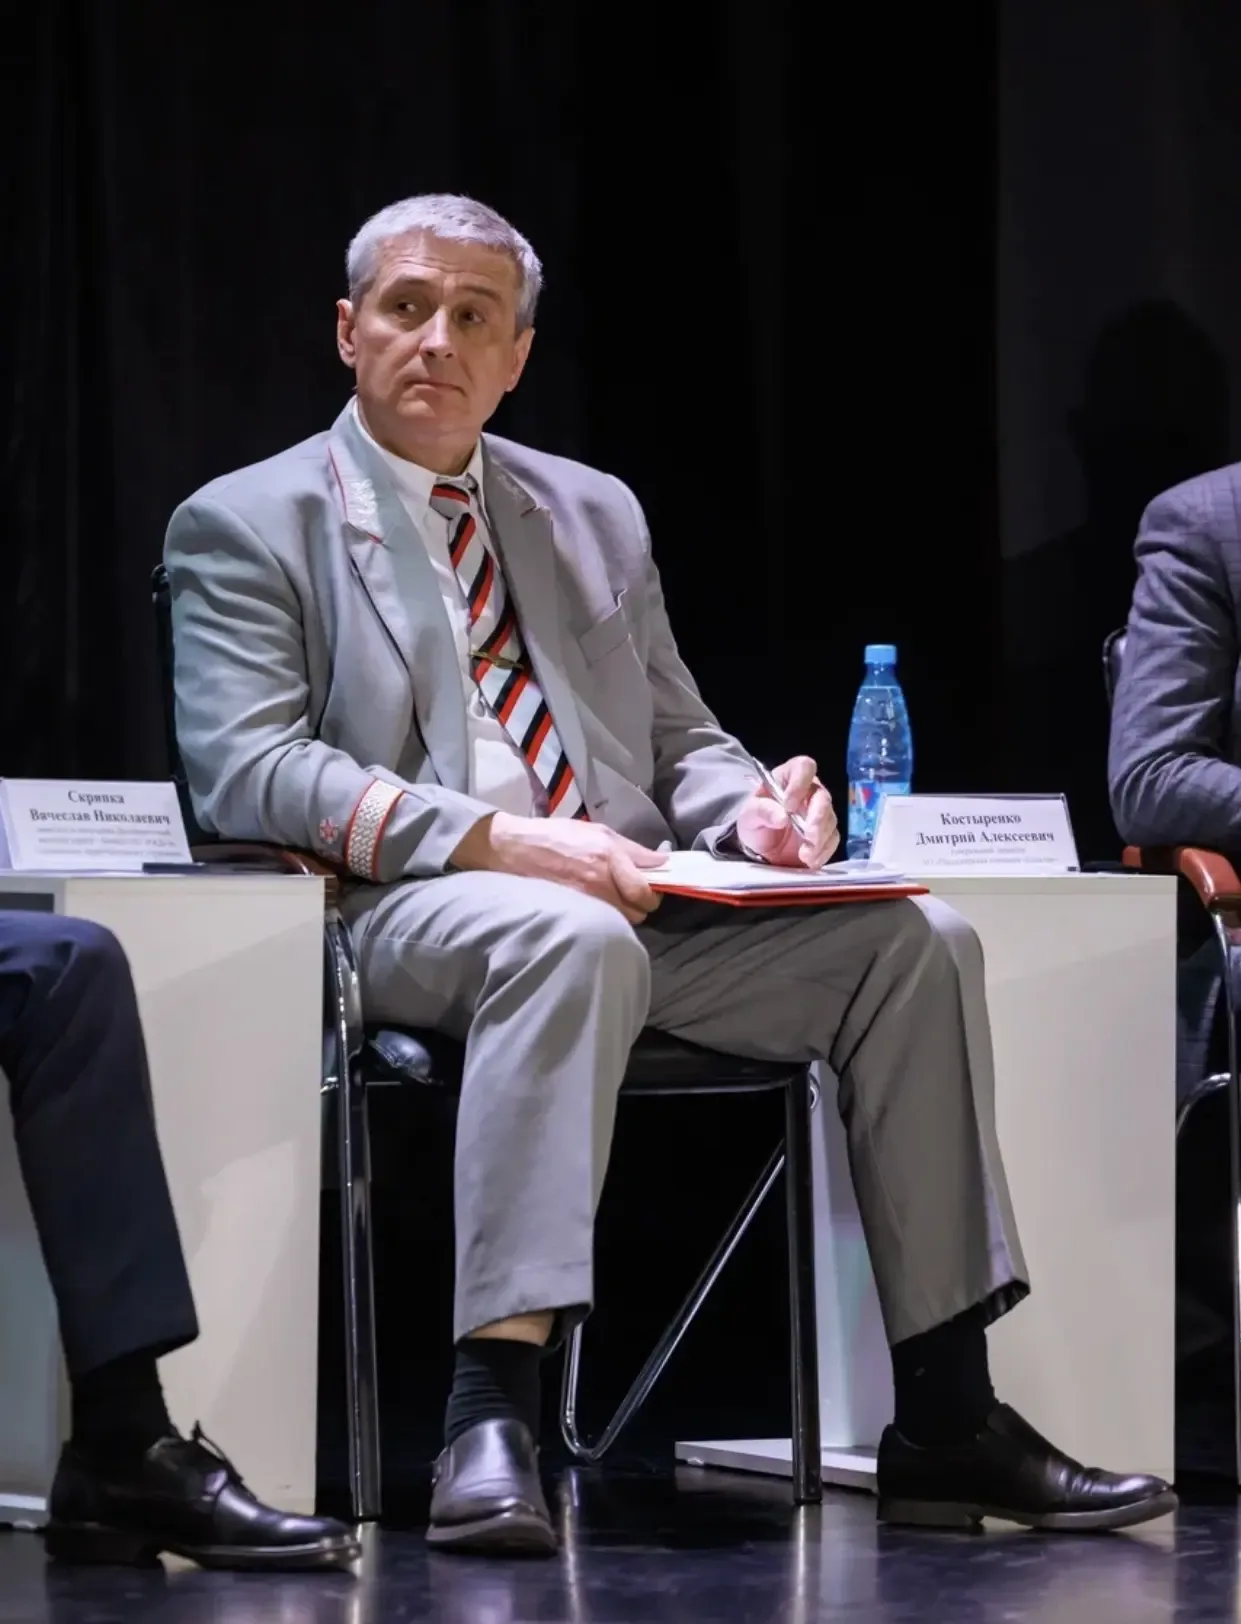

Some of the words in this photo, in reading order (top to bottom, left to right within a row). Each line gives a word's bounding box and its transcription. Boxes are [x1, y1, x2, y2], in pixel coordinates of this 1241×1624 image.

[30, 809, 91, 822] Вячеслав
[94, 810, 170, 825] Николаевич
[940, 813, 1022, 828] Костыренко
[916, 831, 976, 846] Дмитрий
[980, 831, 1055, 843] Алексеевич
